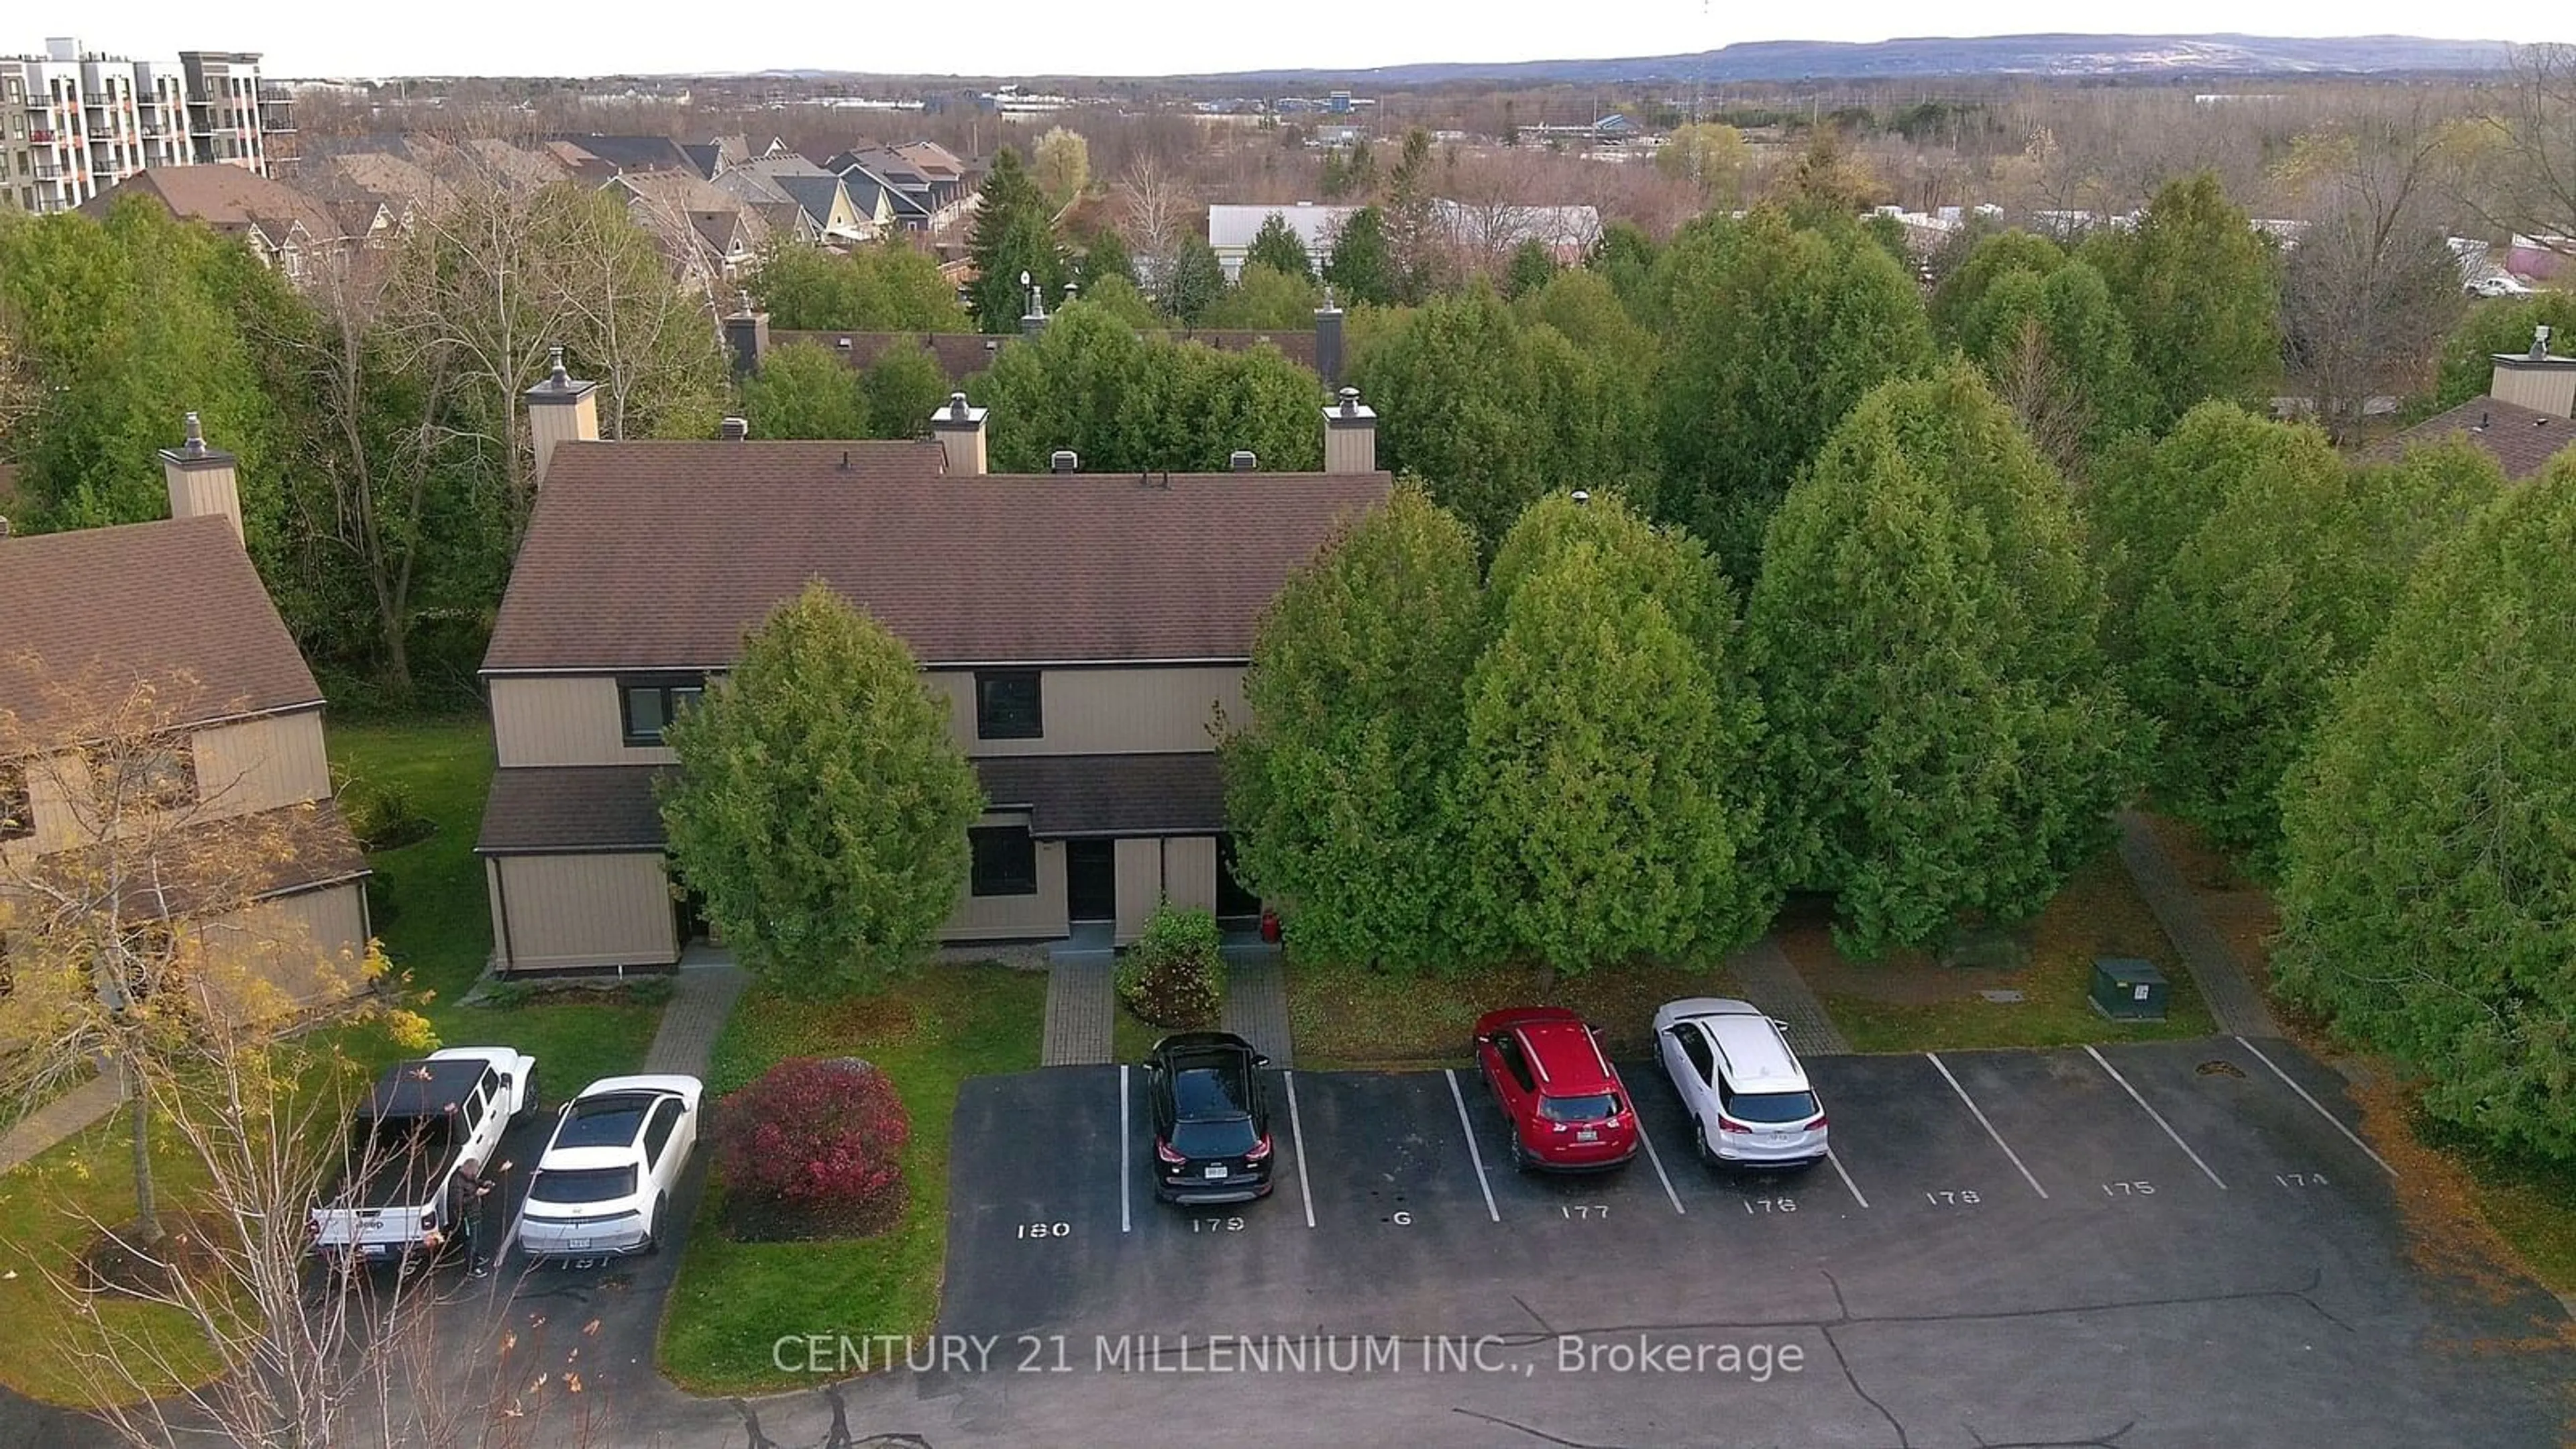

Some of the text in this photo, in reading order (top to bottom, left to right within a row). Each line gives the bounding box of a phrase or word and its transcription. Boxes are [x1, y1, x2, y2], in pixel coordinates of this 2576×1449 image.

[2102, 1181, 2155, 1196] 175
[1927, 1191, 1980, 1205] 178
[1394, 1212, 1411, 1225] G
[1562, 1205, 1609, 1219] 177
[1018, 1222, 1070, 1239] 180
[1193, 1217, 1244, 1232] 179
